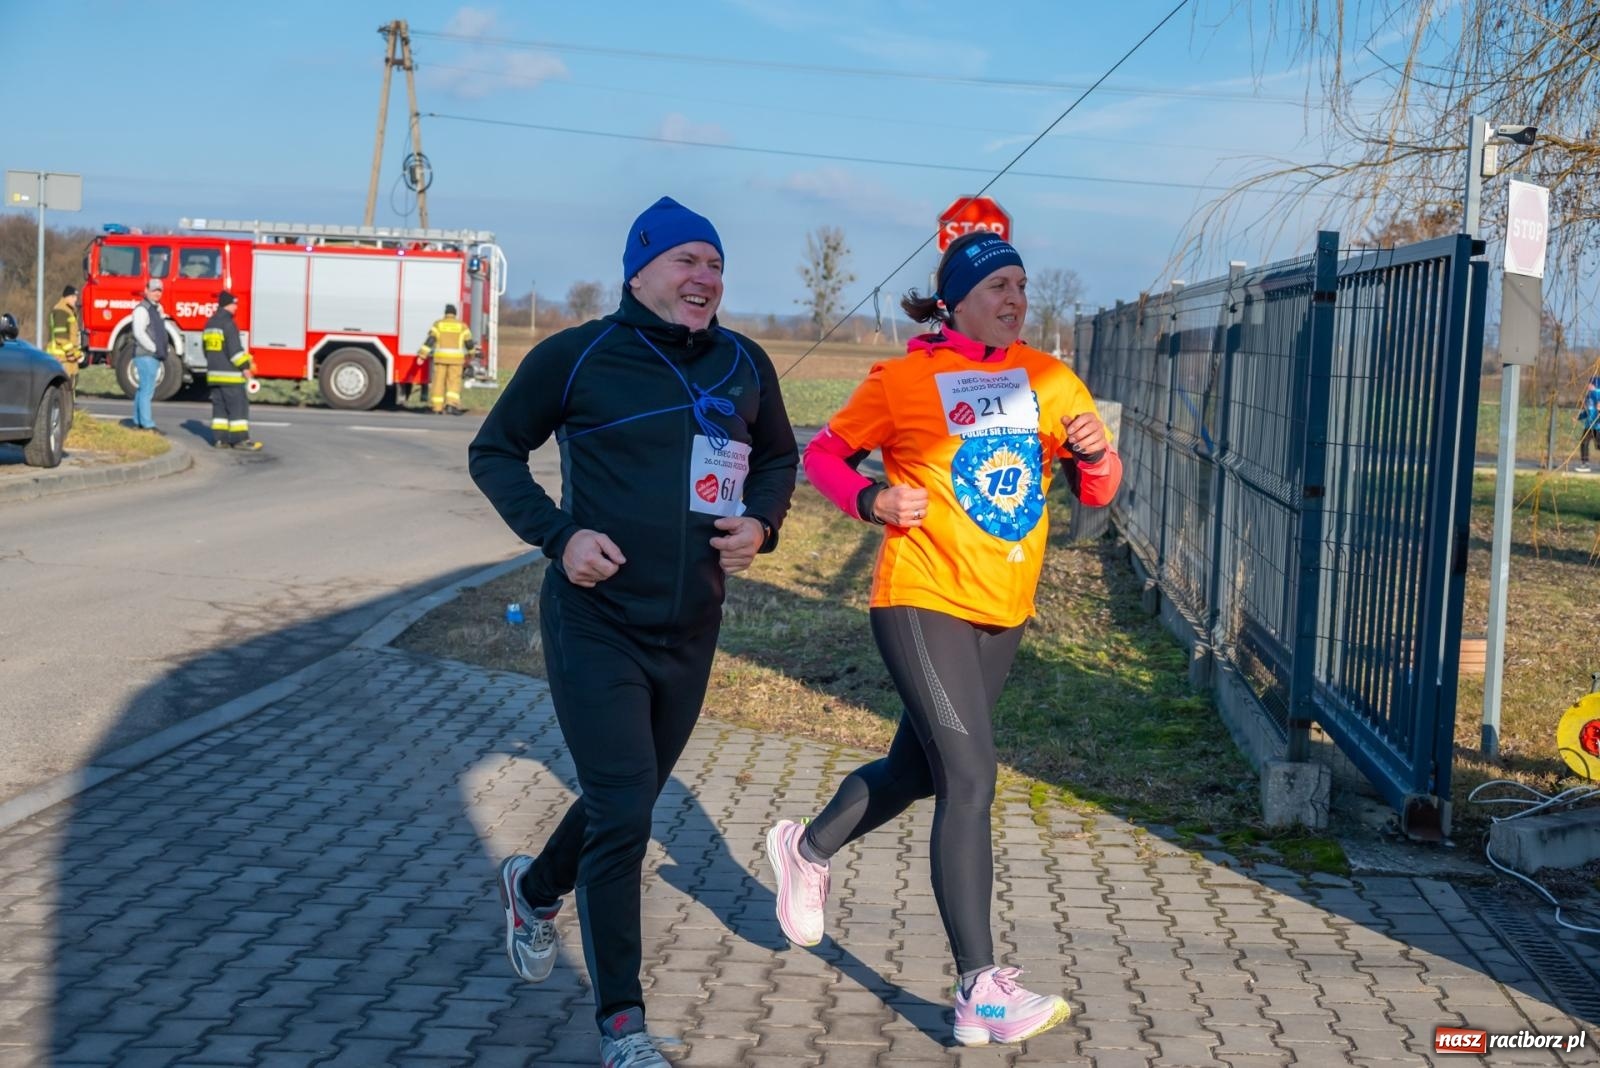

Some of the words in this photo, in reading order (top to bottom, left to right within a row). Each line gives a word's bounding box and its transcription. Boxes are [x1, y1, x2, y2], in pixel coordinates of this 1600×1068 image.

[1512, 218, 1543, 242] STOP
[728, 386, 743, 397] 4F
[961, 377, 979, 385] BIEG
[977, 396, 1008, 417] 21
[721, 477, 736, 501] 61
[985, 467, 1022, 496] 19
[975, 1003, 1006, 1019] HOKA
